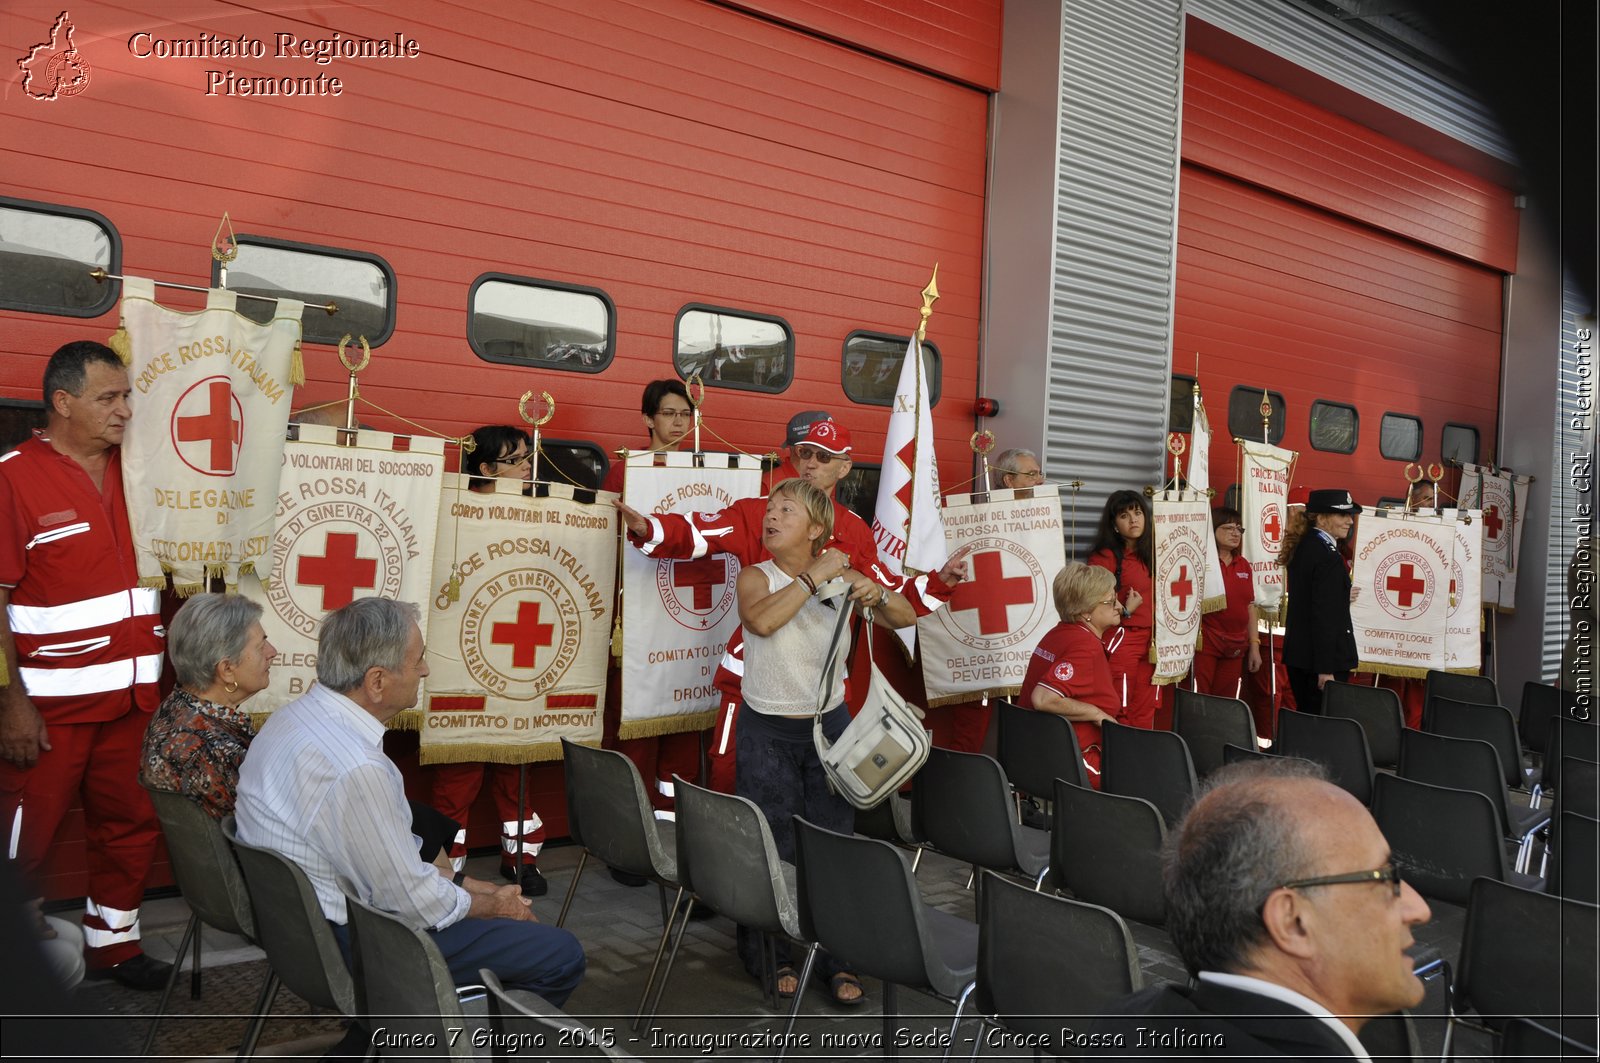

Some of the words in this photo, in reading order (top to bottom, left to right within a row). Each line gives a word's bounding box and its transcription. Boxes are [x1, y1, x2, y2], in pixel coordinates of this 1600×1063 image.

[135, 352, 177, 394] CROCE
[291, 453, 353, 471] VOLONTARI
[357, 458, 375, 473] DEL
[379, 460, 433, 477] SOCCORSO
[676, 483, 712, 500] ROSSA
[216, 511, 229, 525] DI
[288, 518, 304, 535] DI
[306, 504, 373, 527] GINEVRA
[374, 523, 390, 542] 22
[299, 477, 366, 500] ROSSA
[373, 489, 420, 561] ITALIANA
[451, 503, 483, 520] CORPO
[489, 505, 542, 523] VOLONTARI
[547, 510, 561, 524] DEL
[565, 513, 608, 530] SOCCORSO
[944, 512, 987, 526] VOLONTARI
[992, 511, 1007, 521] DEL
[1011, 506, 1050, 519] SOCCORSO
[957, 524, 999, 538] ROSSA
[1004, 519, 1059, 533] ITALIANA
[1359, 532, 1387, 561] CROCE
[1387, 528, 1422, 540] ROSSA
[1421, 533, 1449, 570] ITALIANA
[1455, 530, 1472, 562] ALIANA
[994, 540, 1005, 549] DI
[1007, 544, 1042, 577] GINEVRA
[1395, 553, 1422, 564] GINEVRA
[486, 537, 550, 560] ROSSA
[553, 546, 606, 620] ITALIANA
[508, 573, 562, 599] GINEVRA
[486, 581, 503, 598] DI
[560, 599, 575, 616] 22
[720, 591, 733, 612] 1864
[464, 598, 507, 692] CONVENZIONE
[555, 620, 578, 669] AGOSTO
[1365, 629, 1405, 640] COMITATO
[1406, 635, 1433, 644] LOCALE
[648, 646, 709, 664] COMITATO
[947, 650, 1031, 669] DELEGAZIONE
[1364, 646, 1393, 657] LIMONE
[1395, 650, 1431, 660] PIEMONTE
[701, 665, 710, 676] DI
[952, 664, 1028, 683] PEVERAG
[674, 685, 719, 701] DRONE
[427, 714, 508, 729] COMITATO
[514, 717, 529, 730] DI
